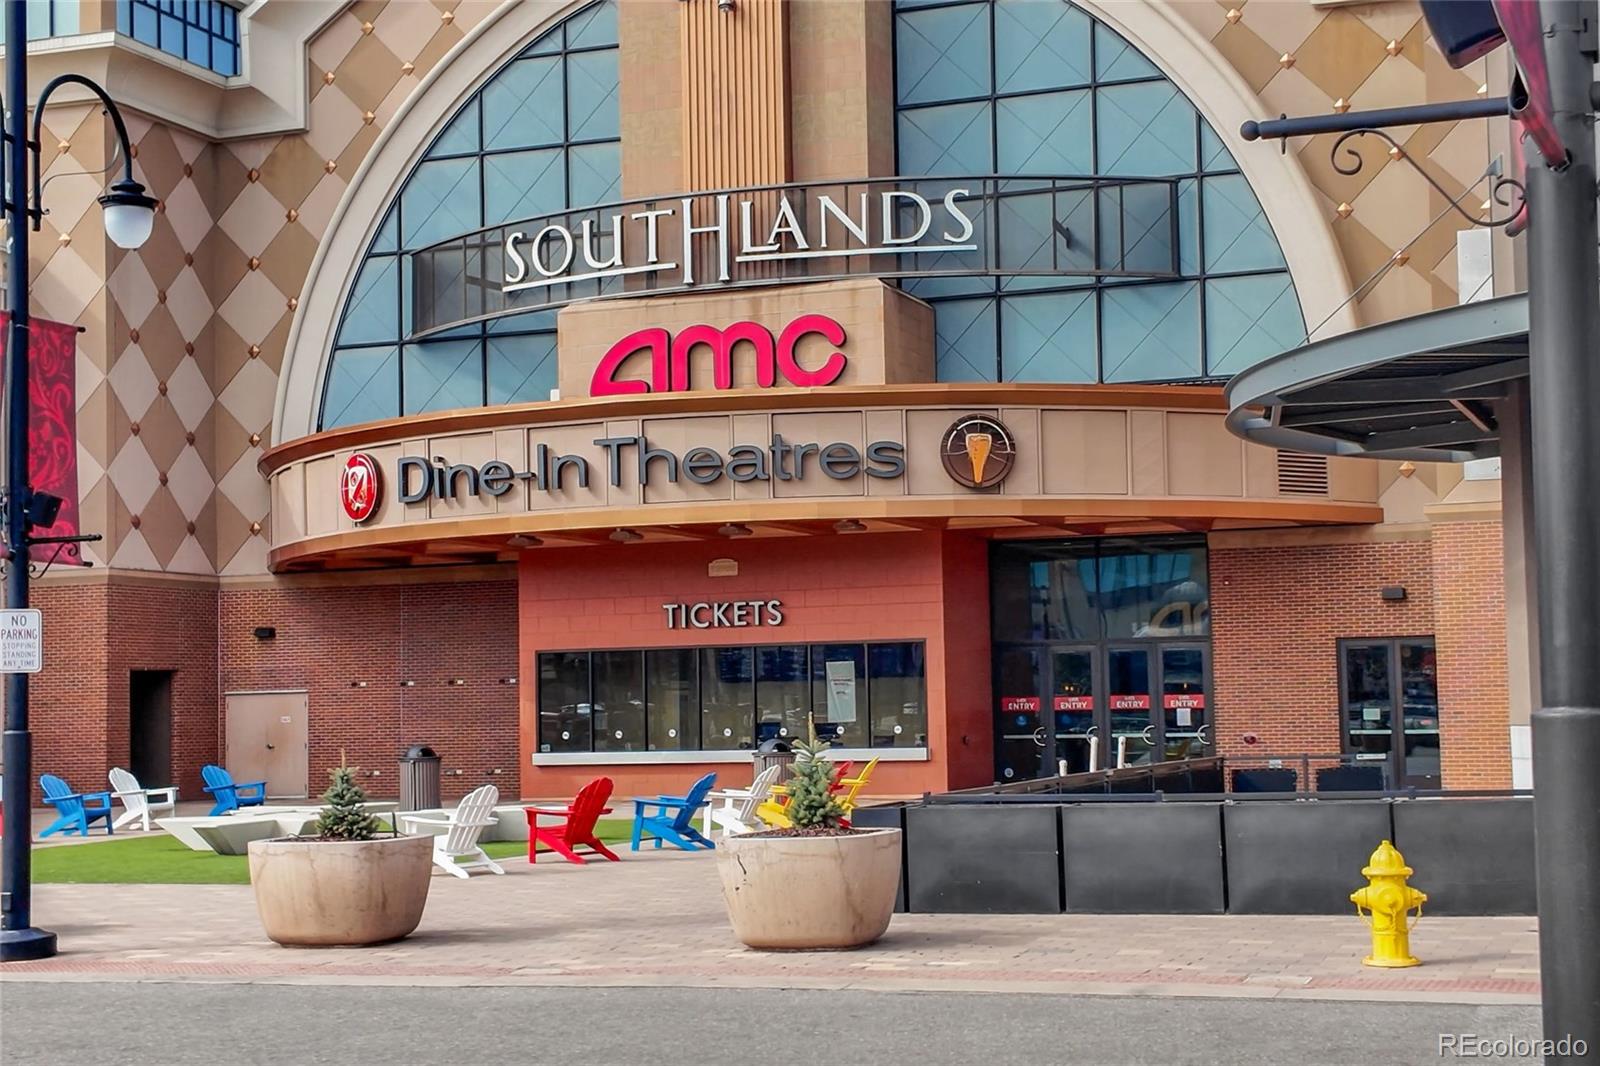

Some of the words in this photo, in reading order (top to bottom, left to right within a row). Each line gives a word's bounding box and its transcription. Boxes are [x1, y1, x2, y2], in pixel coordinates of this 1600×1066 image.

[503, 188, 977, 286] SOUTHLANDS
[398, 442, 590, 504] Dine-In
[593, 434, 906, 488] Theatres
[663, 599, 784, 629] TICKETS
[11, 615, 27, 626] NO
[0, 628, 38, 640] PARKING
[2, 642, 37, 650] STOPPING
[2, 651, 37, 659] STANDING
[1008, 702, 1035, 711] ENTRY
[1060, 701, 1088, 710] ENTRY
[1116, 700, 1144, 709] ENTRY
[1170, 699, 1199, 708] ENTRY
